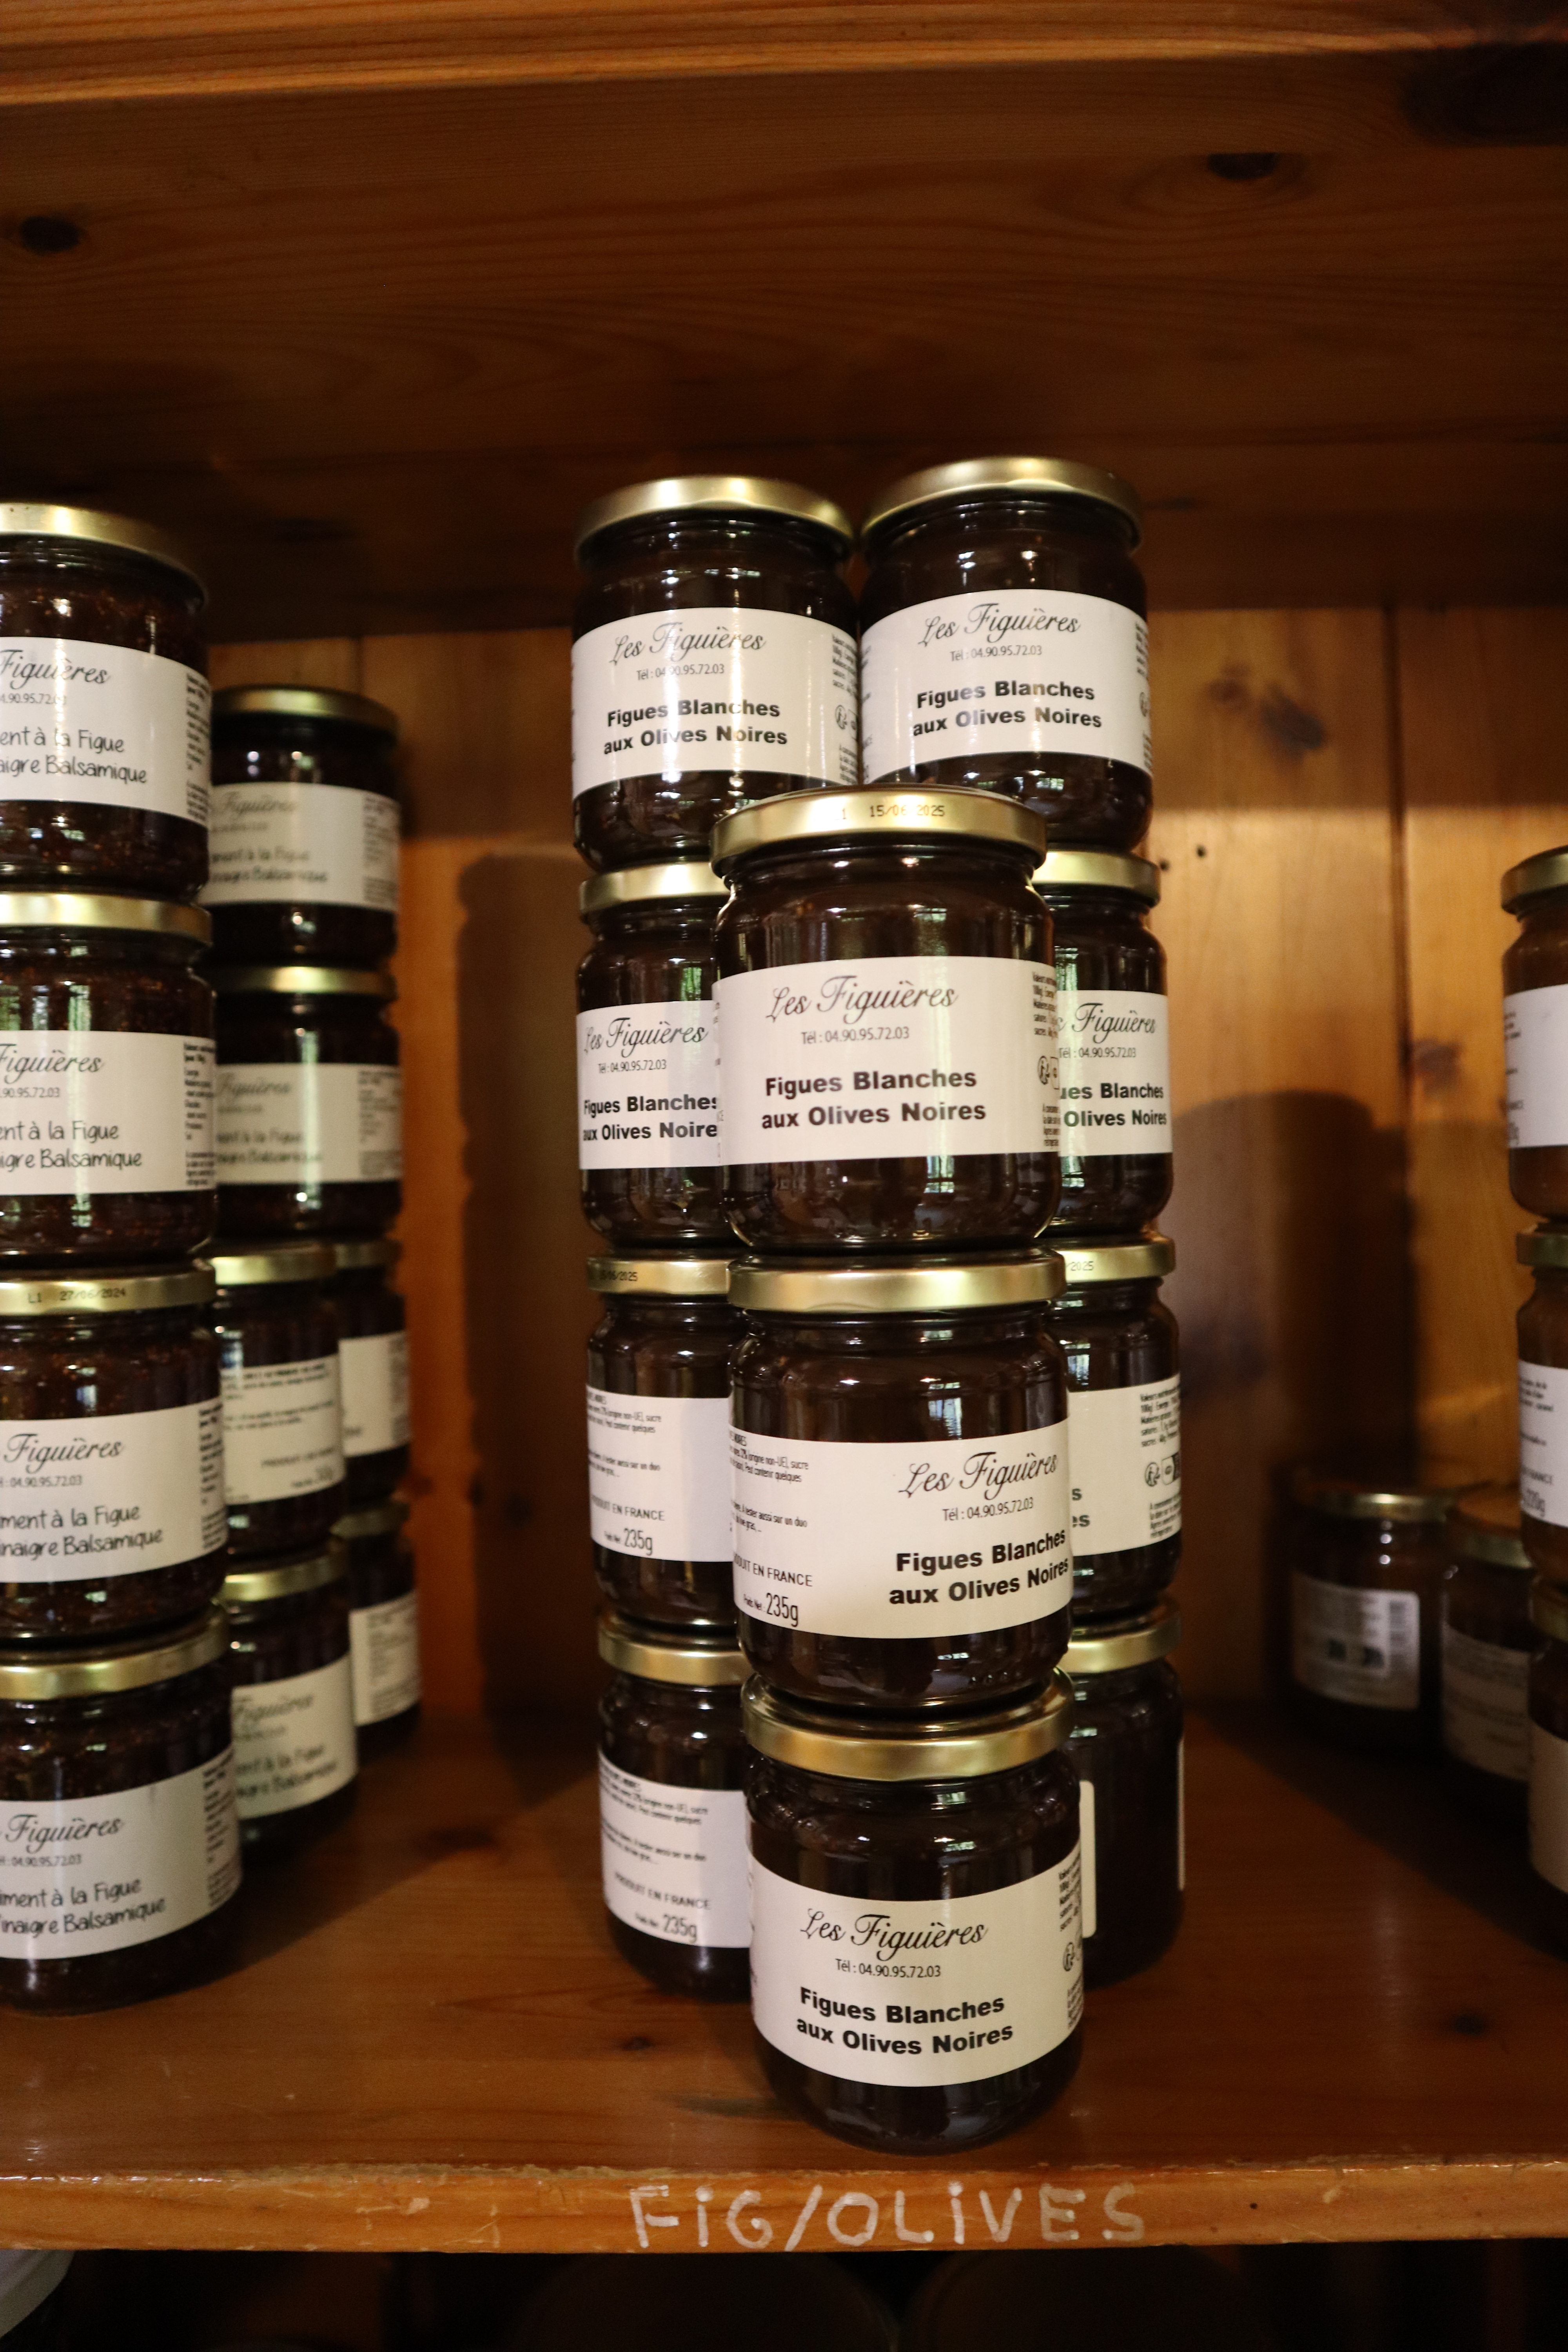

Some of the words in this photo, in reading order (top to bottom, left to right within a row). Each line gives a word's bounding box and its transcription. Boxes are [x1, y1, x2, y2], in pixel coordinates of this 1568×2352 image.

[918, 615, 960, 647] Les
[964, 603, 1082, 643] Figuières
[609, 635, 645, 666] Les
[649, 622, 766, 662] Figuières
[950, 650, 964, 662] Tél
[971, 645, 1043, 659] 04.90.95.72.03
[637, 670, 649, 681] Tél
[917, 682, 985, 709] Figues
[995, 681, 1095, 701] Blanches
[608, 704, 668, 728] Figues
[677, 699, 781, 717] Blanches
[912, 717, 947, 736] aux
[956, 709, 1025, 728] Olives
[1035, 707, 1102, 728] Noires
[34, 726, 46, 746] à
[55, 728, 71, 747] la
[78, 729, 125, 753] Figue
[604, 735, 633, 755] aux
[641, 726, 707, 747] Olives
[716, 726, 788, 745] Noires
[45, 754, 147, 784] Balsamique
[766, 986, 811, 1023] Les
[817, 975, 959, 1024] Figuières
[801, 1031, 816, 1044] Tél
[825, 1027, 910, 1042] 04.90.95.72.03
[1072, 1002, 1156, 1044] Figuières
[584, 1026, 604, 1055] Les
[606, 1017, 709, 1058] Figuières
[610, 1059, 667, 1073] 04.90.95.72.03
[1079, 1047, 1136, 1058] 04.90.95.72.03
[766, 1074, 843, 1099] Figues
[854, 1069, 977, 1091] Blanches
[1100, 1082, 1163, 1099] Blanches
[584, 1100, 620, 1118] Figues
[627, 1094, 717, 1112] Blanches
[762, 1110, 799, 1129] aux
[808, 1103, 890, 1126] Olives
[902, 1102, 986, 1122] Noires
[1064, 1110, 1125, 1127] Olives
[1131, 1109, 1167, 1125] Noires
[28, 1120, 40, 1140] à
[49, 1120, 65, 1140] la
[72, 1120, 119, 1144] Figue
[583, 1128, 598, 1141] aux
[602, 1124, 651, 1140] Olives
[660, 1122, 717, 1138] Noire
[40, 1148, 142, 1170] Balsamique
[3, 1433, 123, 1474] Figuières
[790, 1461, 809, 1470] sucre
[898, 1463, 954, 1498] Les
[959, 1452, 1058, 1500] Figuières
[51, 1510, 63, 1528] à
[71, 1508, 87, 1526] la
[94, 1505, 140, 1528] Figue
[624, 1506, 665, 1521] FRANCE
[794, 1516, 808, 1528] duo
[942, 1508, 959, 1522] Tél
[967, 1497, 1034, 1519] 04.90.95.72.03
[64, 1528, 163, 1555] Balsamique
[624, 1528, 653, 1556] 235g
[896, 1552, 983, 1576] Figues
[992, 1529, 1065, 1564] Blanches
[753, 1563, 765, 1577] EN
[767, 1567, 813, 1587] FRANCE
[889, 1589, 939, 1605] aux
[949, 1577, 1021, 1602] Olives
[1028, 1557, 1069, 1588] Noires
[766, 1592, 799, 1628] 235g
[4, 1814, 123, 1854] Figuières
[51, 1888, 63, 1907] à
[71, 1886, 87, 1905] la
[94, 1880, 142, 1903] Figue
[63, 1898, 166, 1934] Balsamique
[663, 1914, 697, 1944] 235g
[800, 1907, 846, 1940] Les
[850, 1914, 988, 1962] Figuières
[835, 1958, 851, 1973] Tél
[859, 1963, 941, 1978] 04.90.95.72.03
[800, 1987, 876, 2021] Figues
[886, 1996, 1005, 2024] Blanches
[797, 2018, 834, 2043] aux
[843, 2030, 922, 2055] Olives
[933, 2024, 1013, 2054] Noires
